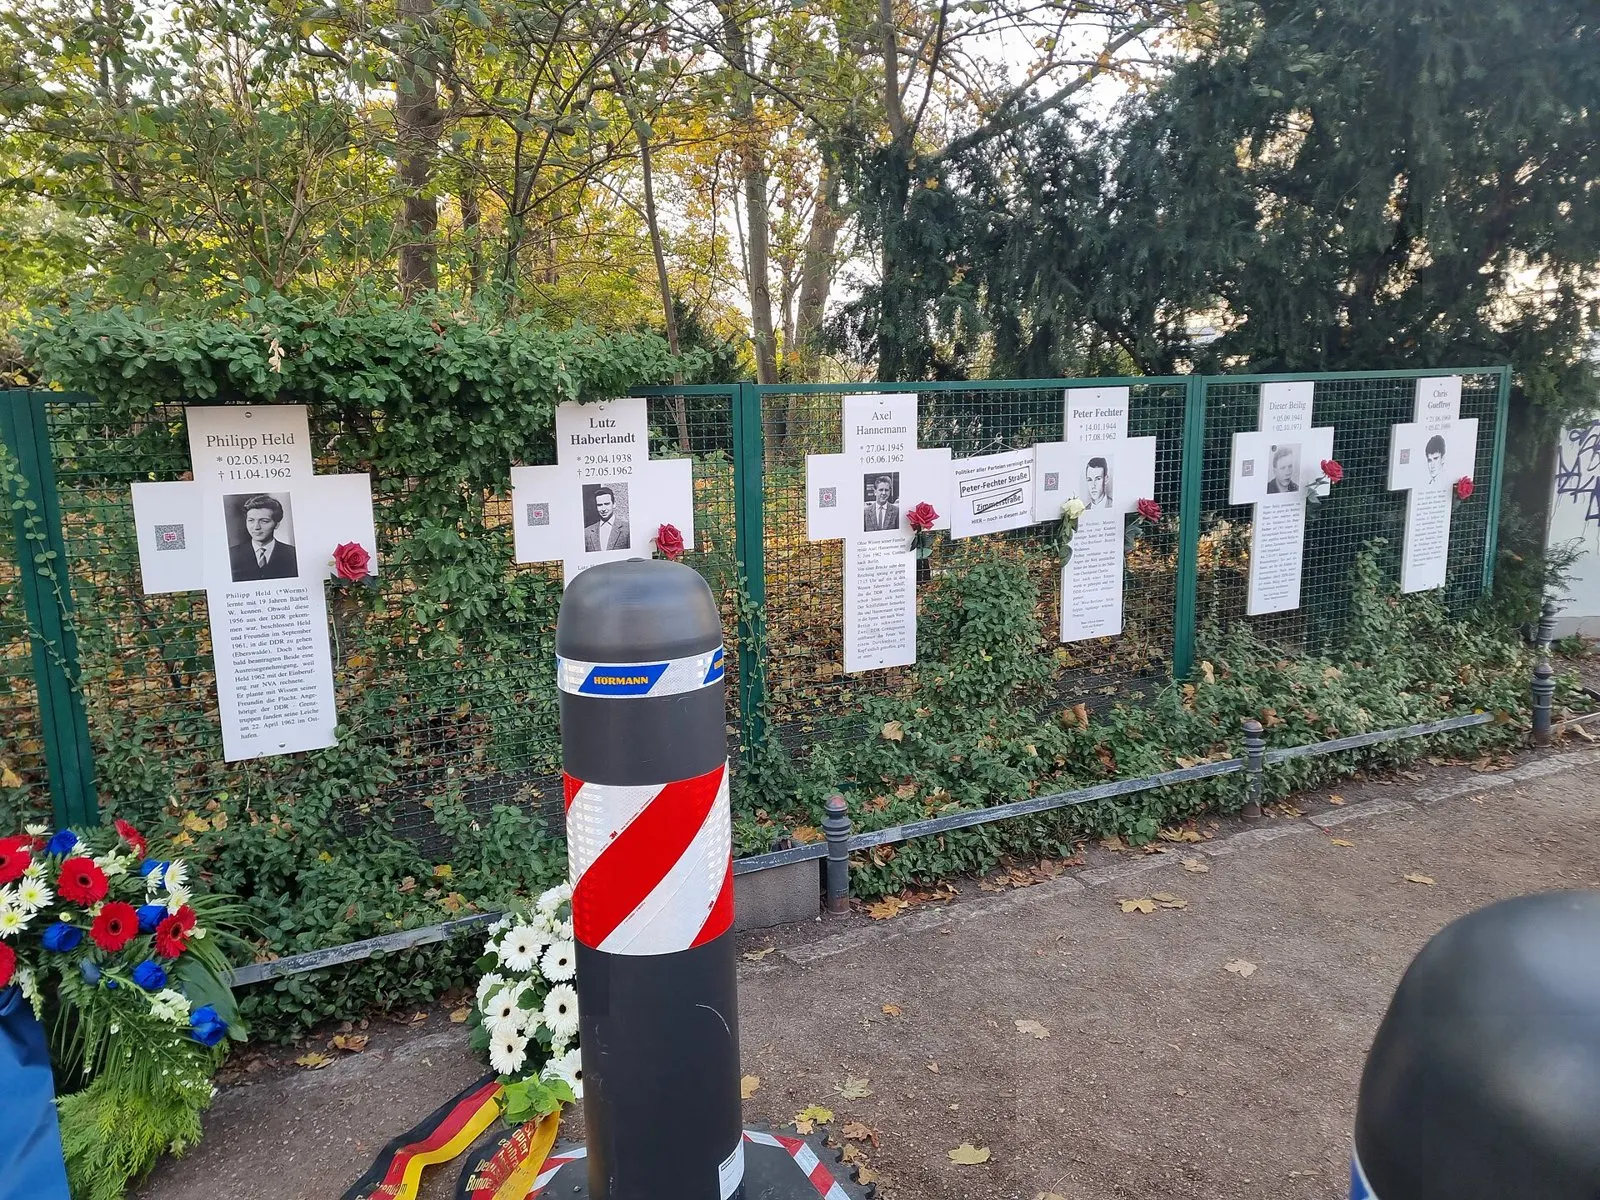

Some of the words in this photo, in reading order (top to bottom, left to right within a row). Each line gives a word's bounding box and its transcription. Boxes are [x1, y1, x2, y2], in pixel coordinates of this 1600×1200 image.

[872, 411, 892, 420] Axel
[1073, 410, 1093, 418] Peter
[1096, 408, 1123, 417] Fechter
[590, 418, 616, 428] Lutz
[856, 426, 907, 435] Hannemann
[206, 434, 257, 449] Philipp
[261, 433, 295, 445] Held
[571, 433, 636, 445] Haberlandt
[866, 443, 904, 453] 27.04.1945
[227, 454, 290, 466] 02.05.1942
[585, 454, 632, 464] 29.04.1938
[866, 454, 904, 464] 05.06.1962
[230, 468, 291, 480] 11.04.1962
[585, 466, 633, 477] 27.05.1962
[956, 468, 976, 476] Politiker
[962, 478, 1007, 493] Peter-Fechter
[1008, 472, 1027, 483] Straße
[976, 495, 1021, 511] Zimmerstraße
[260, 622, 295, 630] beschlossen
[246, 691, 264, 699] plante
[609, 831, 619, 840] 3M
